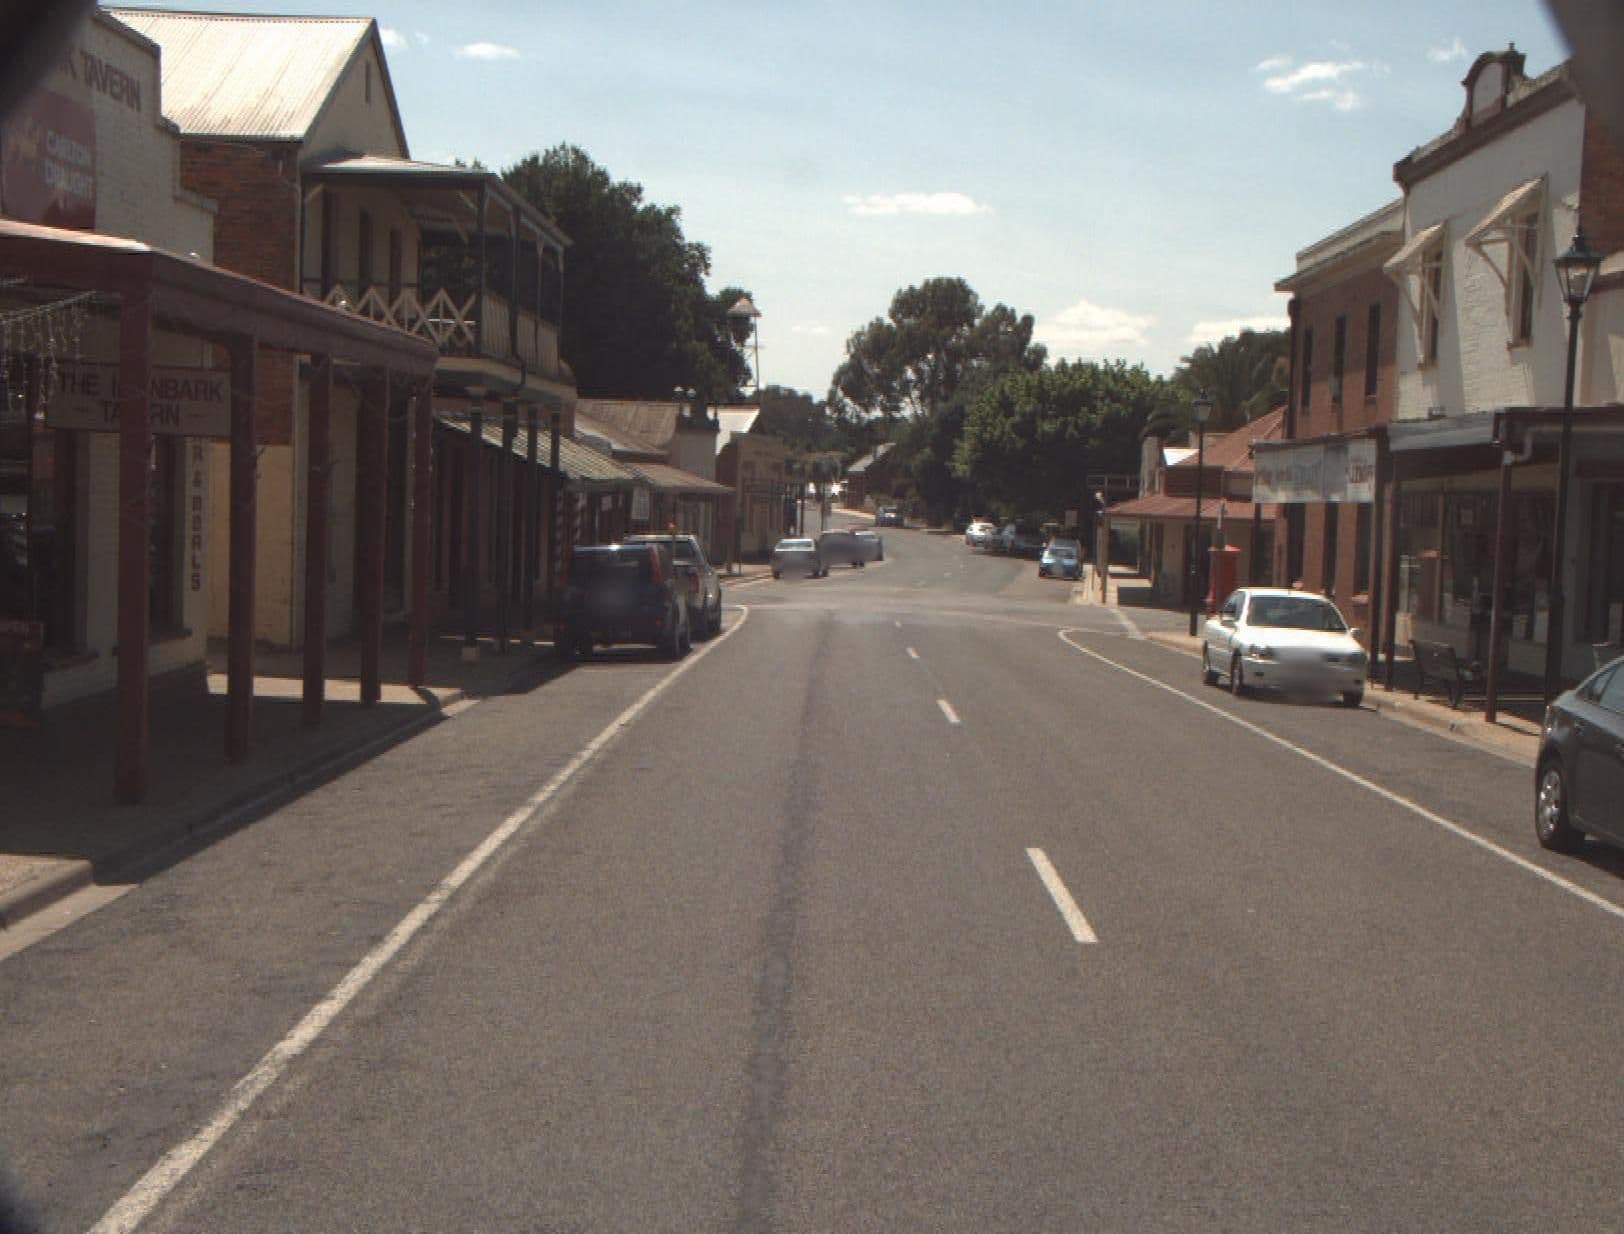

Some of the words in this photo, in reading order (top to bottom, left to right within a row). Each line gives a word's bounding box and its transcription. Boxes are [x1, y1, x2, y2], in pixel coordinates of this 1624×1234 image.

[80, 49, 141, 113] TAVERN
[57, 370, 100, 397] THE
[111, 371, 224, 401] INBARK
[102, 400, 180, 427] TARN
